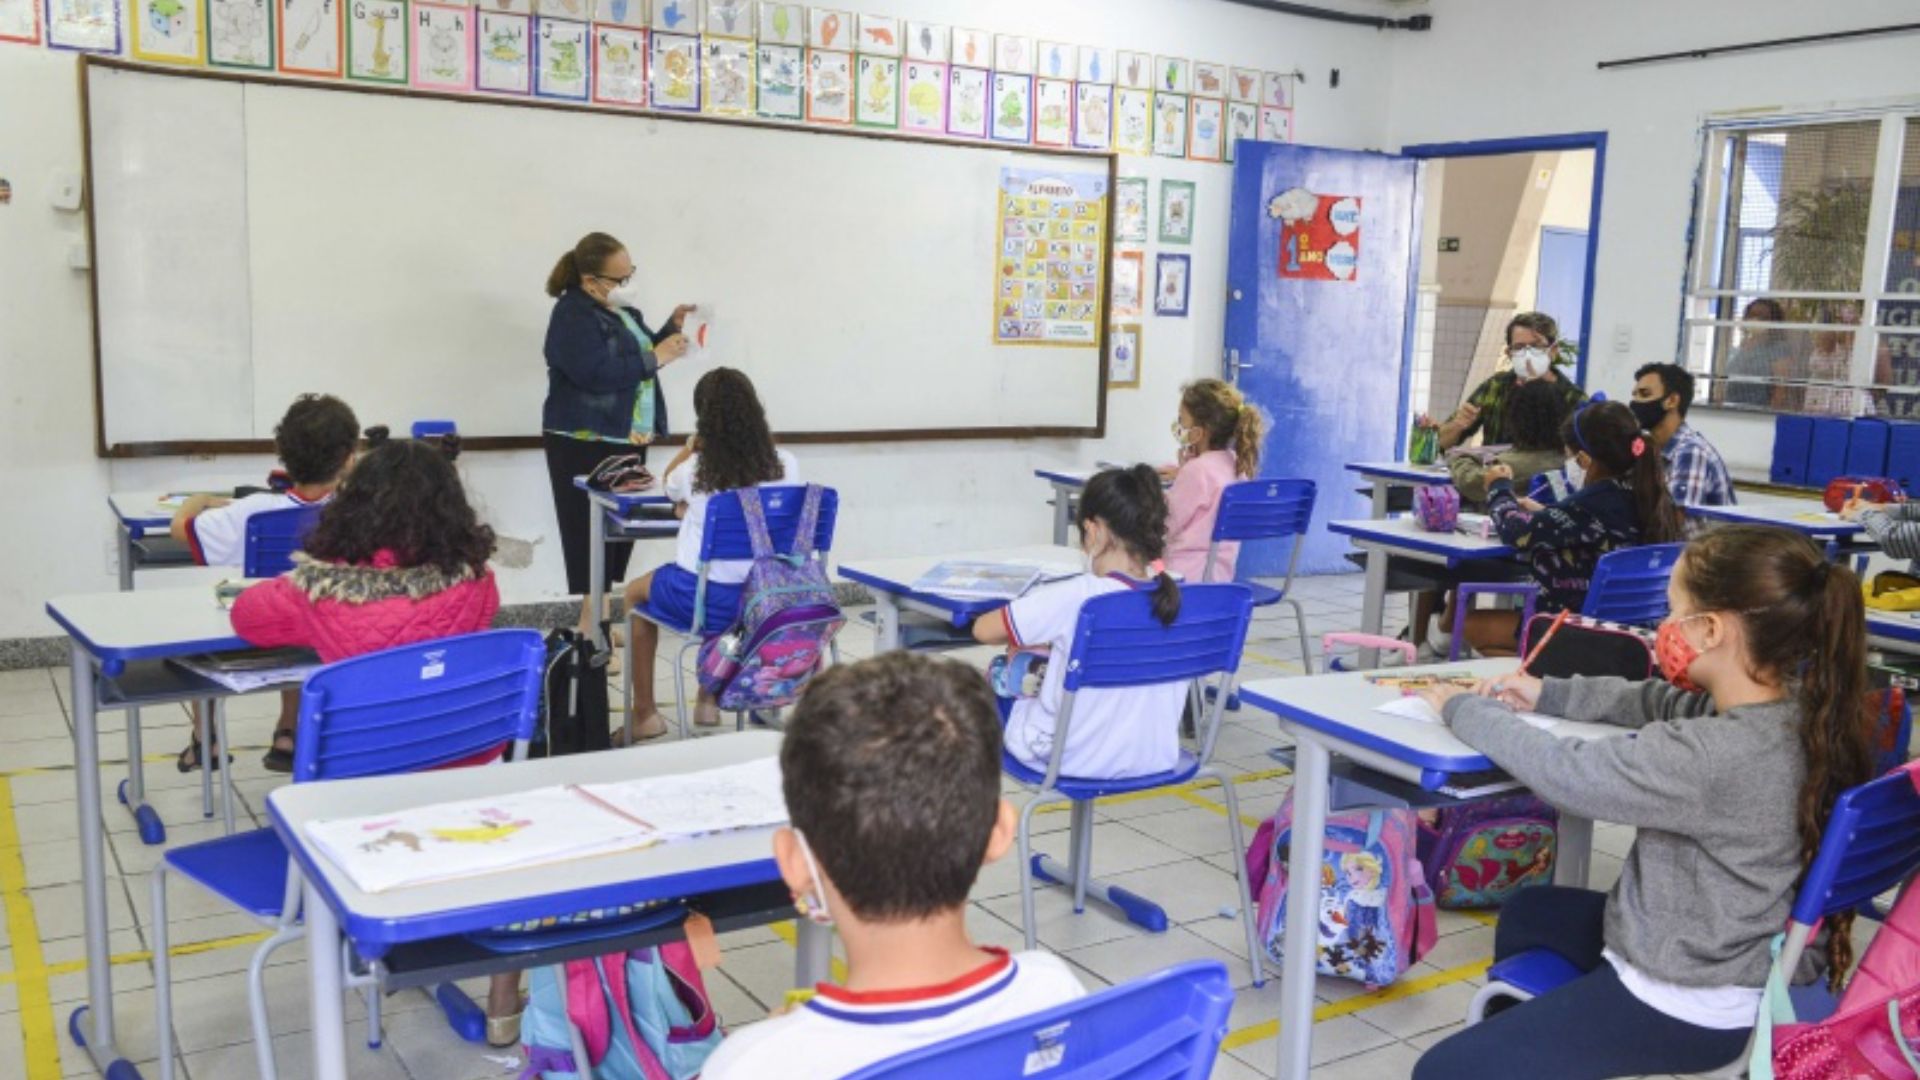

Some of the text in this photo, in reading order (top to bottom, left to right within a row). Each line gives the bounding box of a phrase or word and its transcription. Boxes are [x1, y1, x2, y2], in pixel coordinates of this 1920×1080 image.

[354, 4, 366, 19] G
[419, 11, 464, 31] H h
[542, 23, 553, 39] J
[600, 34, 610, 48] K
[861, 59, 870, 74] P
[996, 78, 1004, 92] S
[1039, 83, 1047, 96] T
